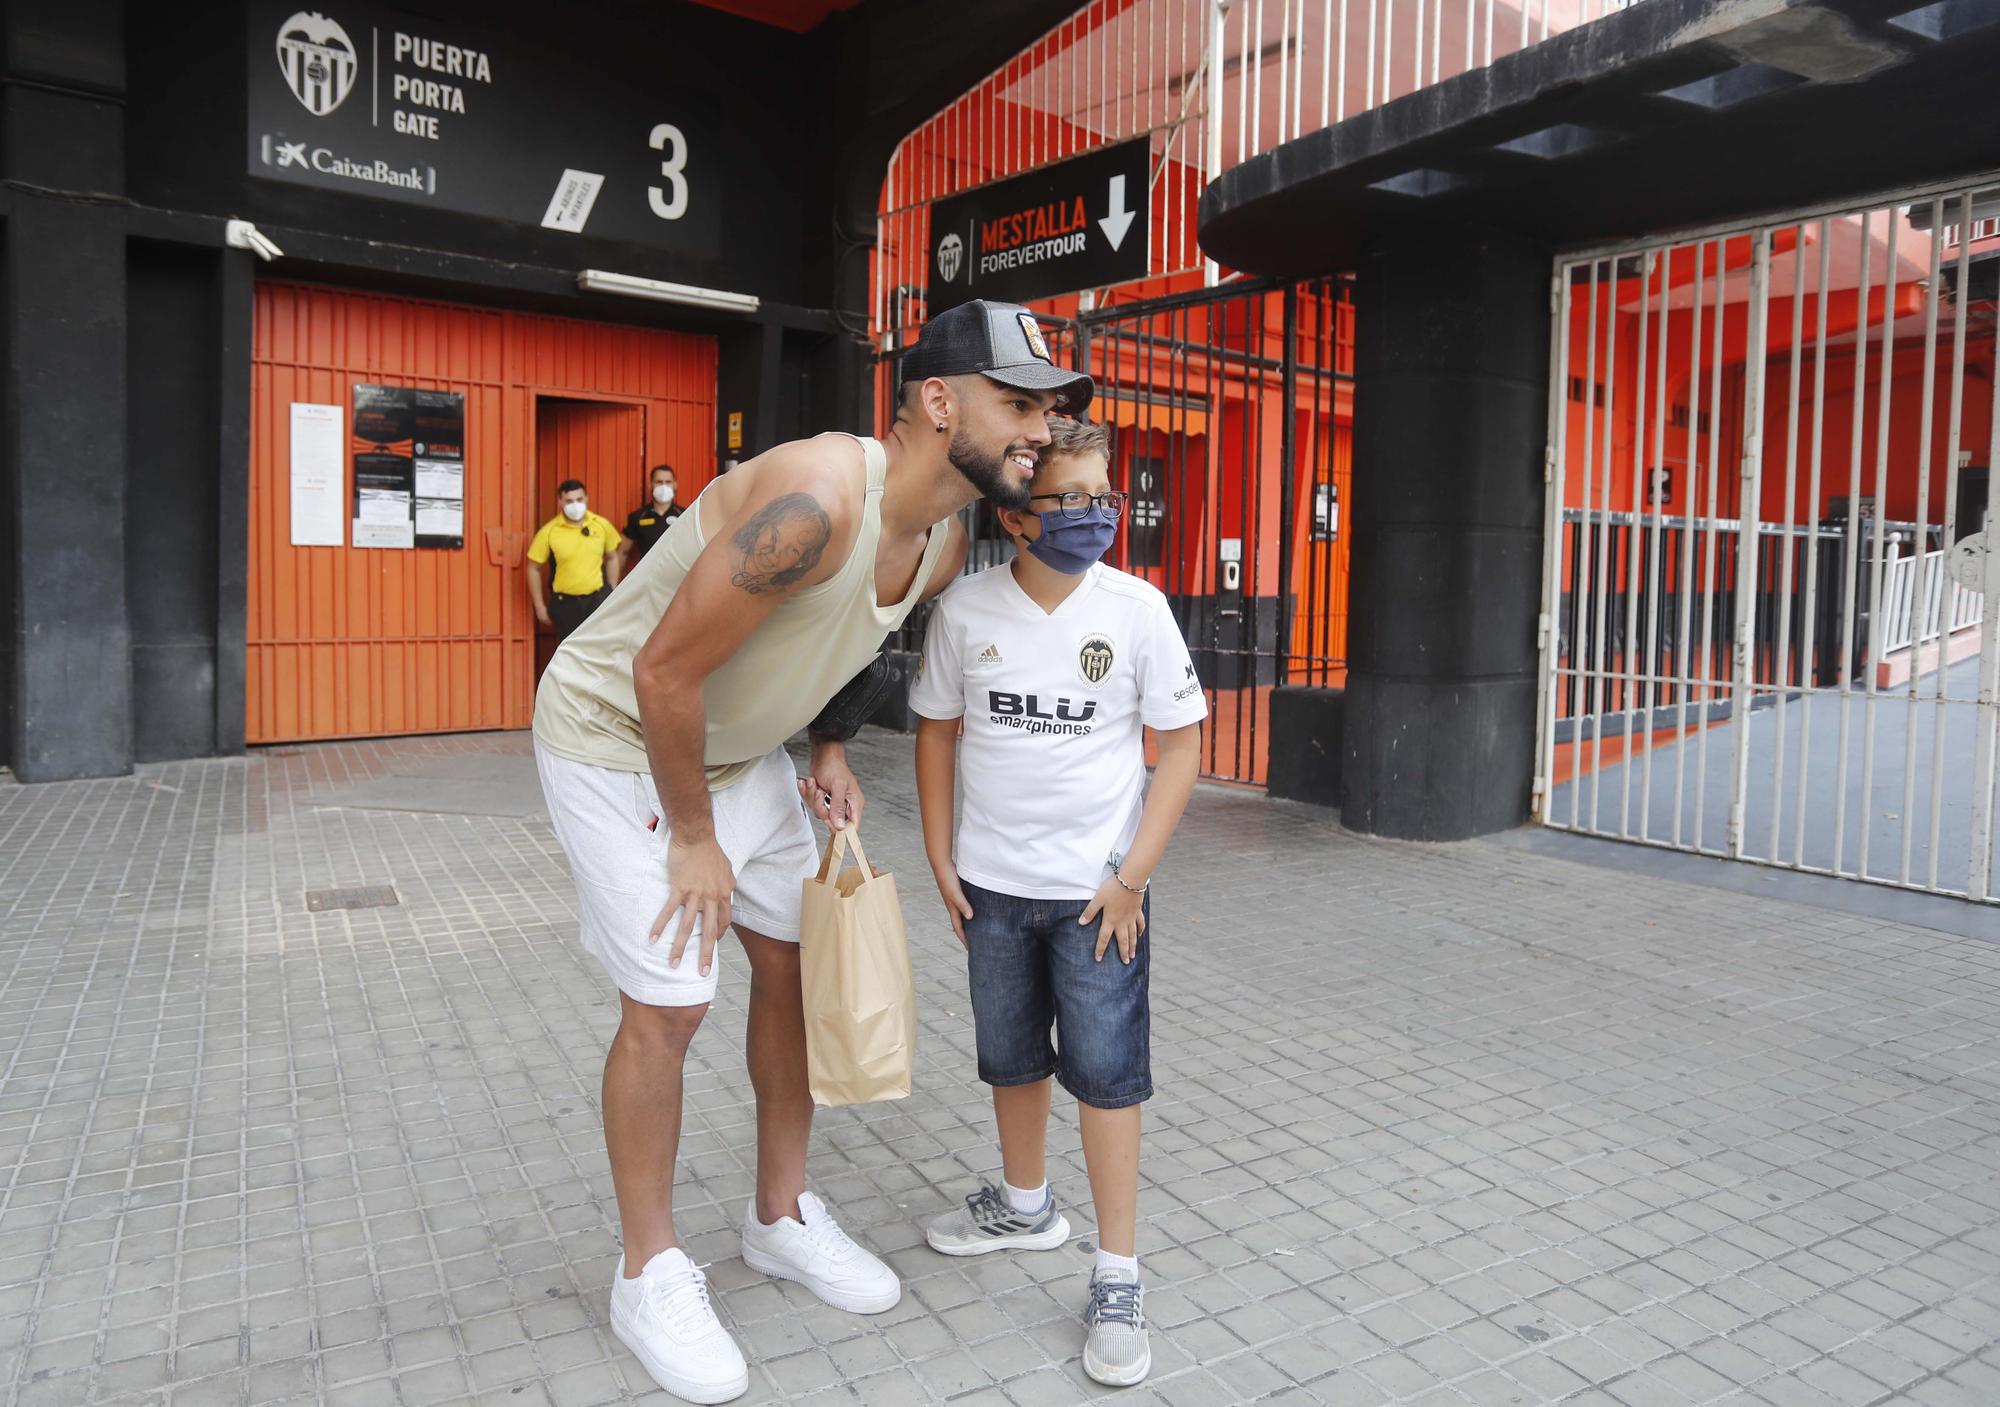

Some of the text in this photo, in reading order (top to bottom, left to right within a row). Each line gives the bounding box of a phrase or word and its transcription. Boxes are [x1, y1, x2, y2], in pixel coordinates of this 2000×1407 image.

[393, 31, 491, 83] PUERTA
[393, 73, 466, 115] PORTA
[393, 108, 440, 140] GATE
[310, 147, 425, 191] CaixaBank
[647, 122, 689, 220] 3
[981, 196, 1087, 254] MESTALLA
[980, 233, 1087, 275] FOREVERTOUR
[989, 712, 1092, 736] smartphones
